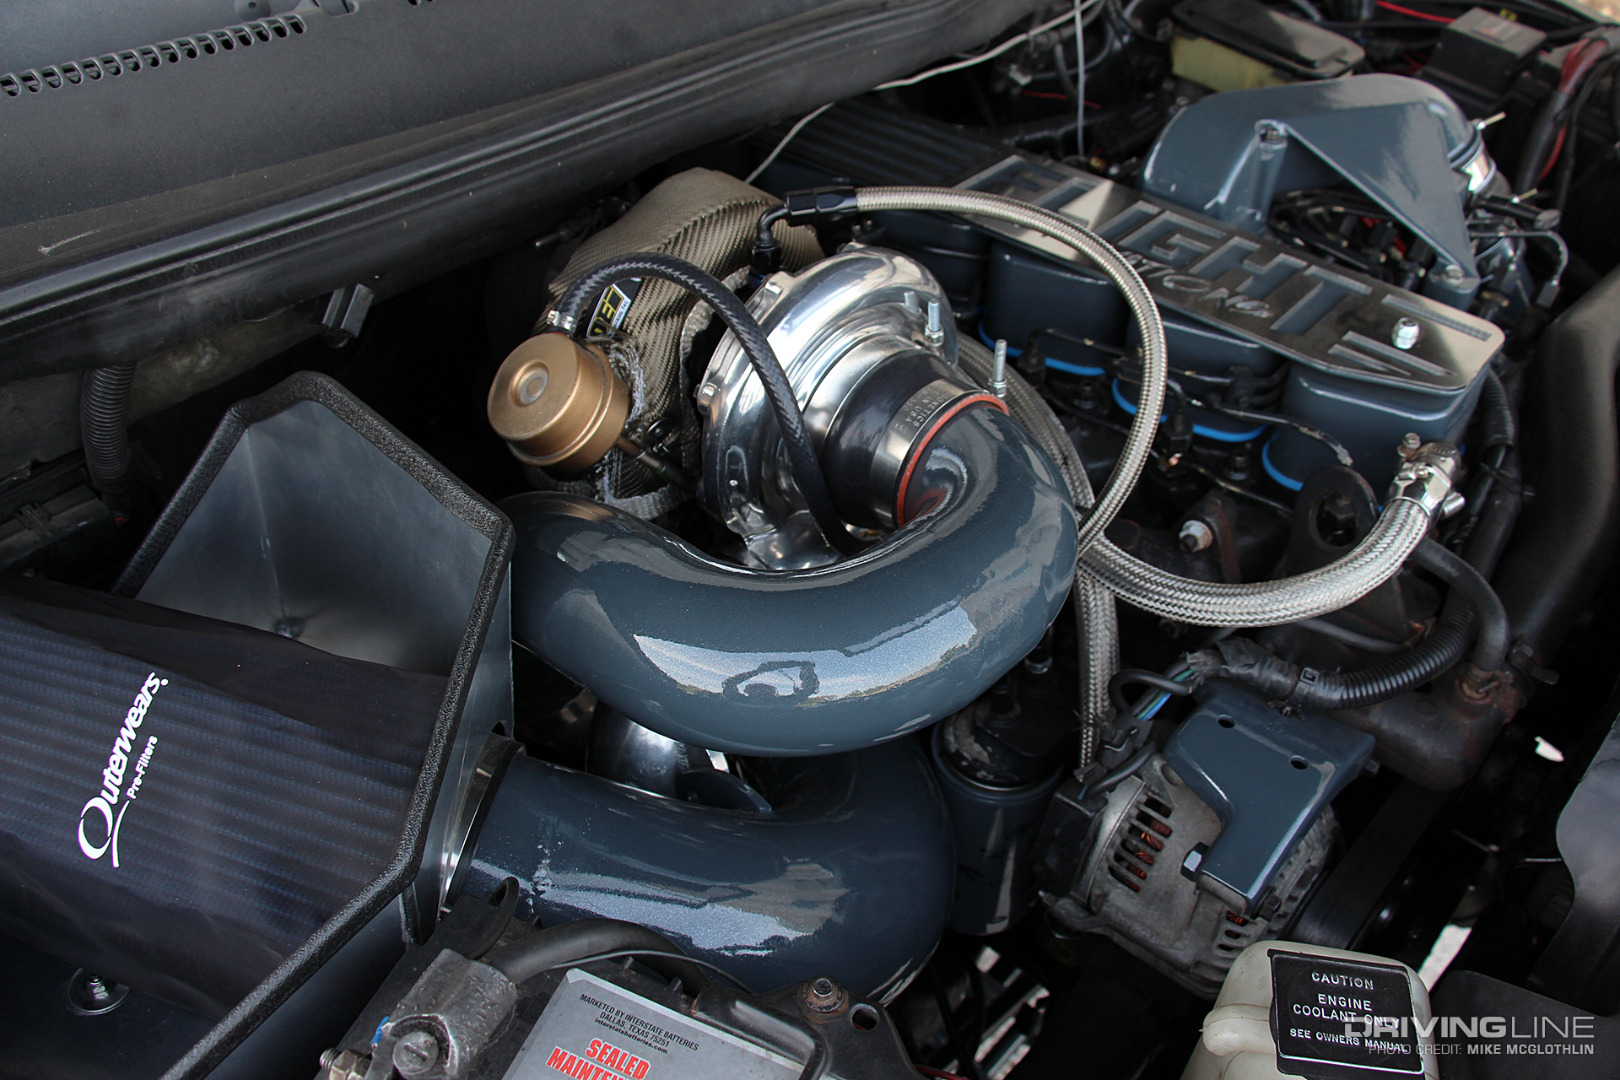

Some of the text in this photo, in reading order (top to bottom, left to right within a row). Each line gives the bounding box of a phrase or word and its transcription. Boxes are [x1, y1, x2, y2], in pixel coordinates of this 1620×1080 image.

[126, 735, 158, 800] Pre-Filters
[1311, 971, 1374, 990] CAUTION
[1293, 1003, 1400, 1029] COOLANT ONLY
[1318, 993, 1373, 1012] ENGINE
[580, 994, 700, 1051] MARKETED BY INTERSTATE BATTERIES
[595, 1017, 668, 1054] interstatebatteries.com
[629, 1024, 650, 1038] TEXAS
[650, 1034, 670, 1048] 75251
[1290, 1028, 1408, 1053] SEE OWNERS MANUAL
[545, 1046, 628, 1080] MAINTE
[585, 1038, 651, 1080] SEALED
